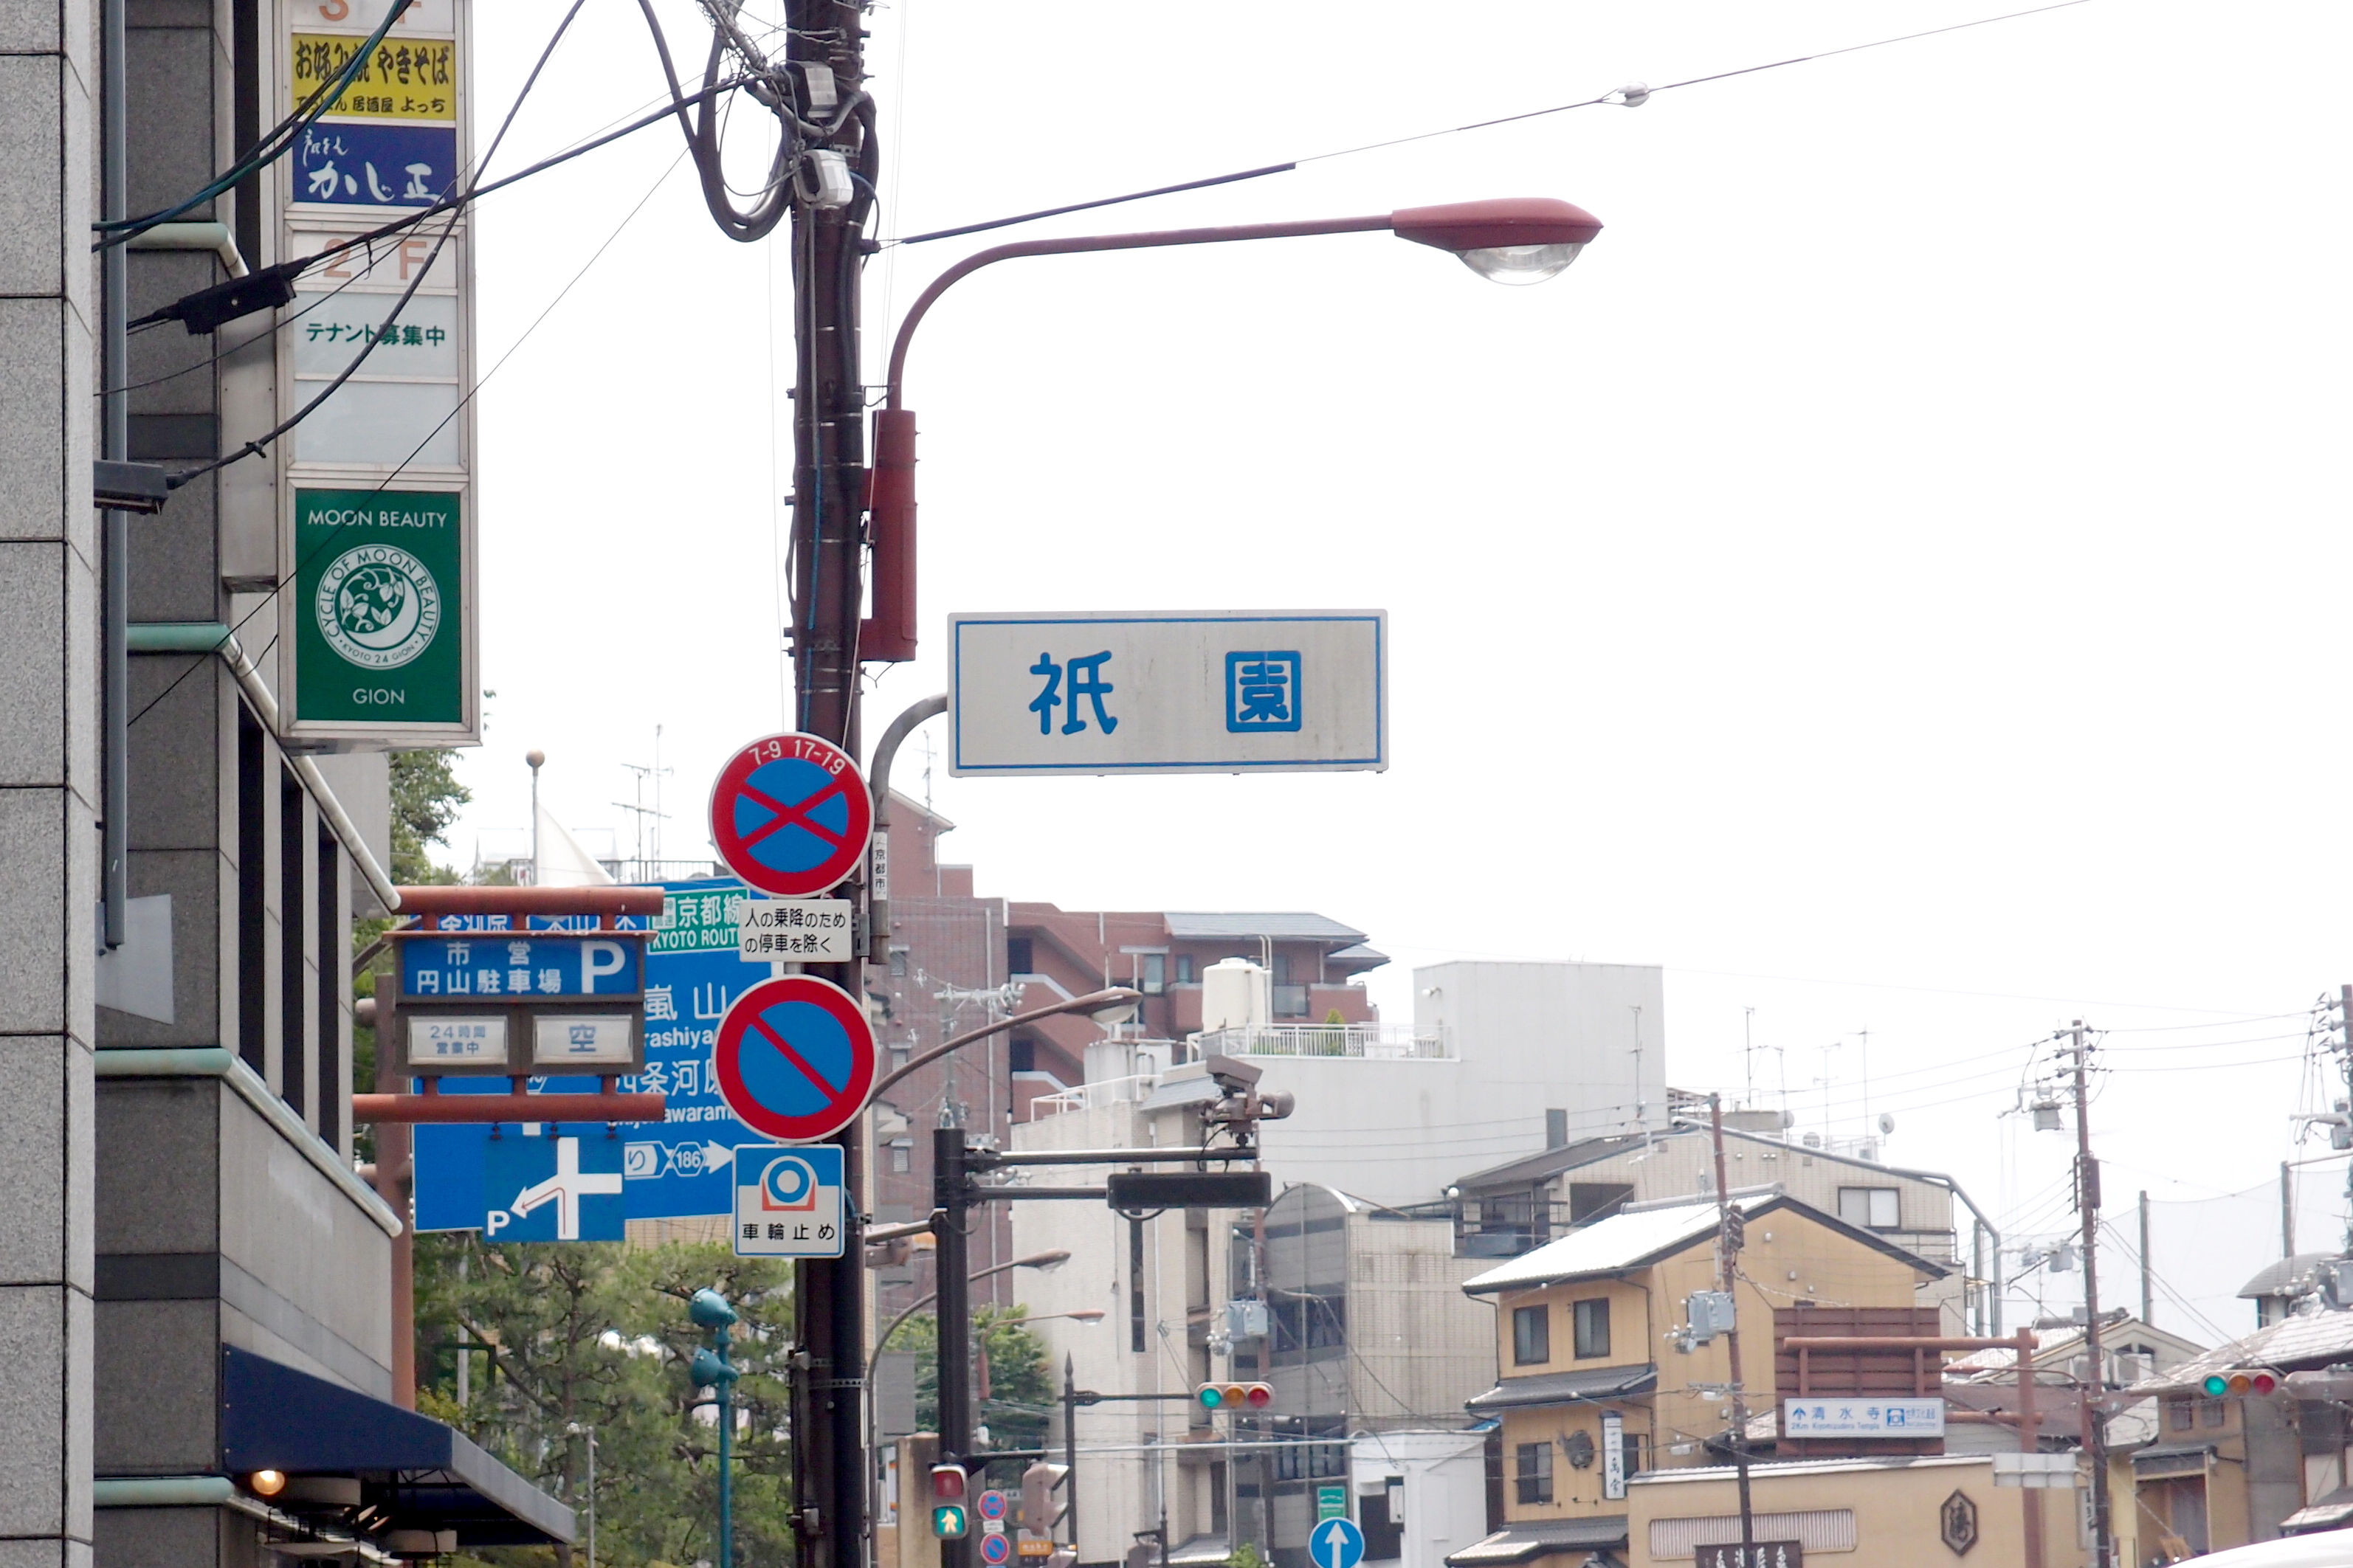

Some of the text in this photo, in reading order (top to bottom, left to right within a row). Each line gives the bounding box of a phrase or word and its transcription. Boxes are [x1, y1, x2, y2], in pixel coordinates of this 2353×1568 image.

[378, 46, 449, 85] やきそば
[353, 96, 393, 112] 居酒屋
[402, 97, 446, 112] よっち
[306, 323, 445, 347] テナント募集中
[307, 509, 447, 528] MOON BEAUTY
[320, 549, 434, 642] CYCLE OF MOON BEAUTY
[342, 642, 416, 663] KYOTO 24 GION
[353, 688, 405, 705] GION
[1029, 650, 1301, 736] 祇園
[748, 739, 847, 776] 7-9 17-19
[744, 908, 847, 928] 人の乗降のため
[652, 927, 740, 949] KYOTO ROUT
[744, 933, 832, 953] の停車を除く
[446, 941, 531, 966] 市営
[581, 940, 626, 994] P
[416, 969, 562, 995] 円山駐車場
[644, 981, 726, 1021] 嵐山
[568, 1024, 597, 1053] 空
[675, 1151, 702, 1169] 186
[487, 1210, 510, 1236] P
[742, 1223, 835, 1240] 車輪止め
